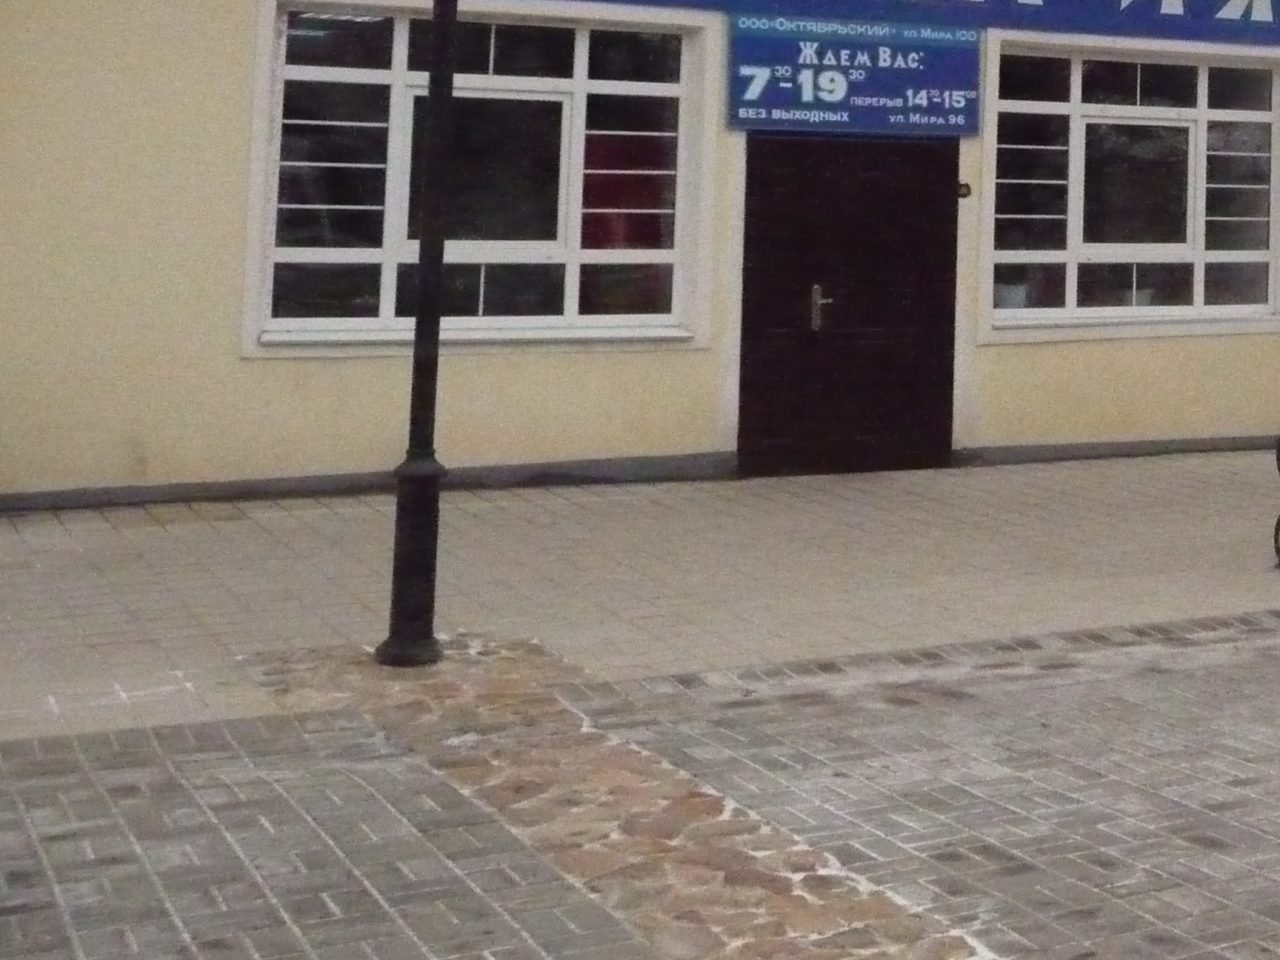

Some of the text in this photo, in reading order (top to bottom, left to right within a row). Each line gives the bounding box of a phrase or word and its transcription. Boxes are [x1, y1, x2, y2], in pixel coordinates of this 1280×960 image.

[956, 31, 977, 41] 100
[797, 41, 872, 67] ЖДЕМ
[850, 96, 904, 108] ПЕРЕРЫВ
[738, 108, 767, 119] БЕЗ
[771, 109, 850, 123] ВЫХОДНЫХ
[909, 113, 945, 125] МИРА
[948, 115, 966, 125] 96
